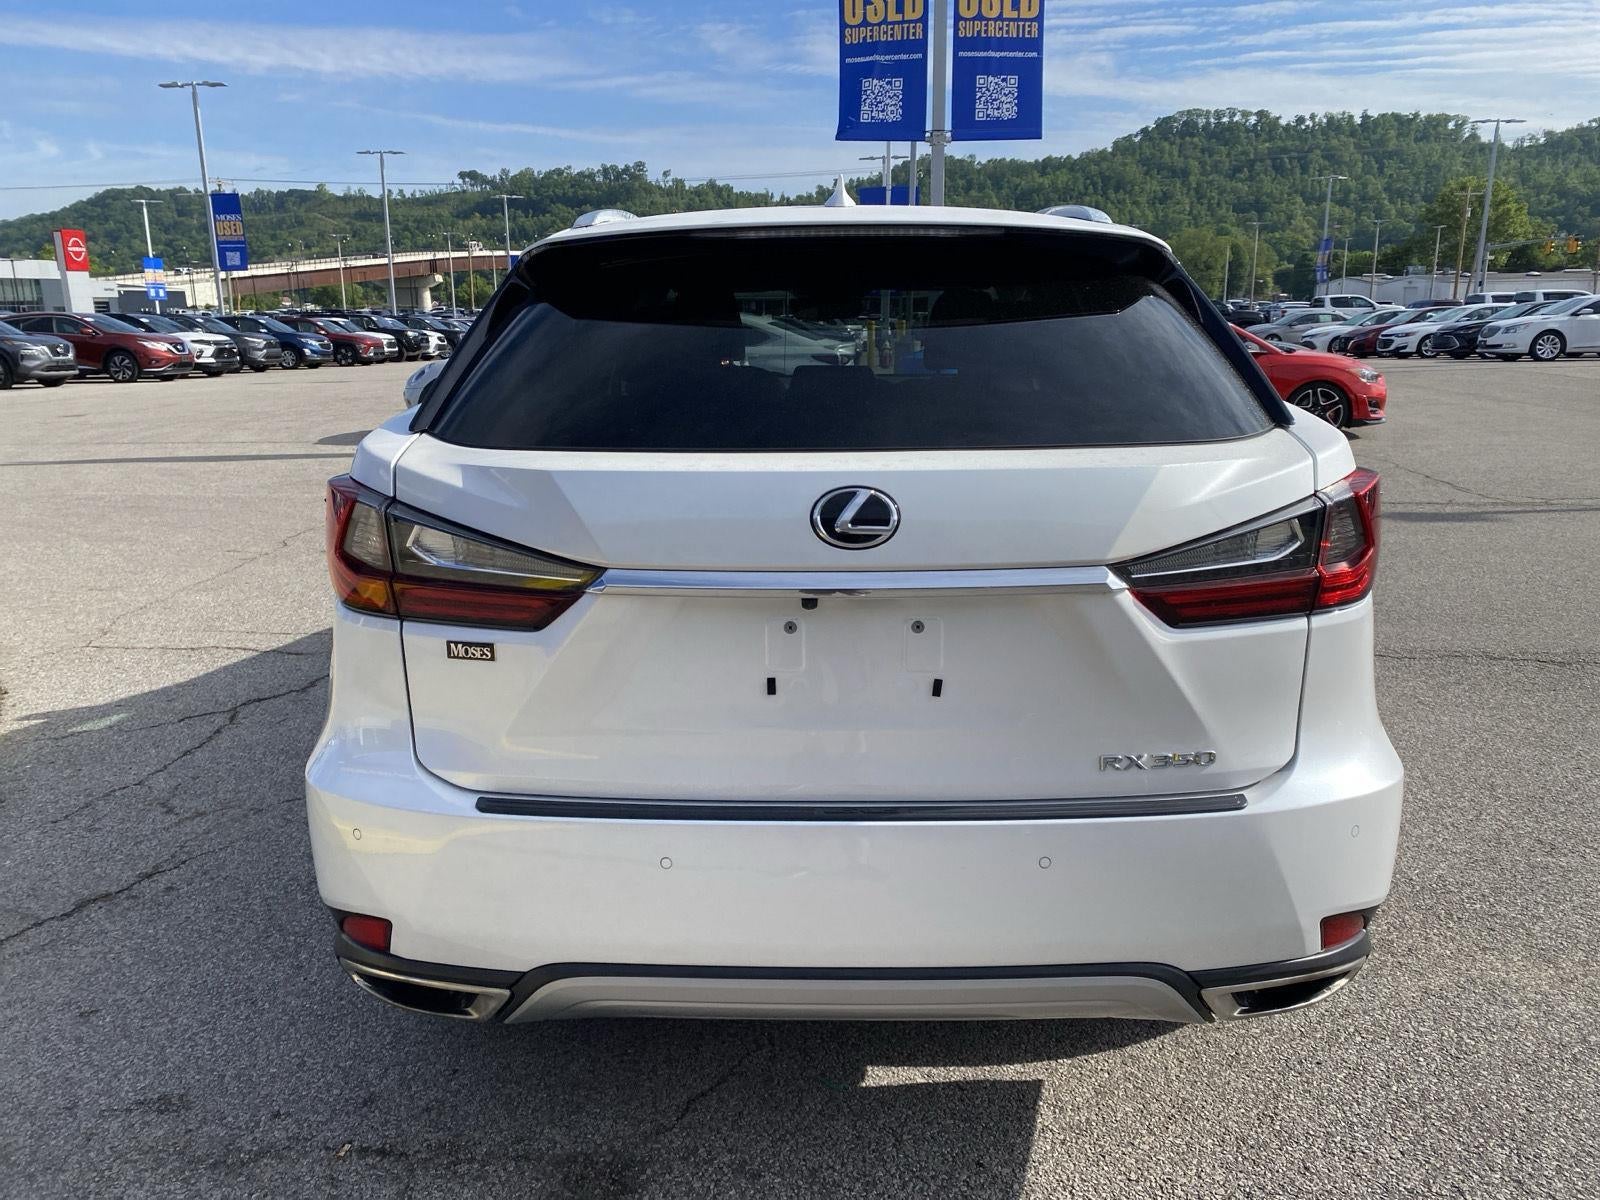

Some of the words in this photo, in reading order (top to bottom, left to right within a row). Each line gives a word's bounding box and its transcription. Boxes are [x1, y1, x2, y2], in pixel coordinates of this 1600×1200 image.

[845, 23, 923, 45] SUPERCENTER
[958, 20, 1039, 38] SUPERCENTER
[845, 53, 923, 64] mosesusedsupercenter.com
[958, 50, 1038, 59] mosesusedsupercenter.com
[216, 221, 244, 236] USED
